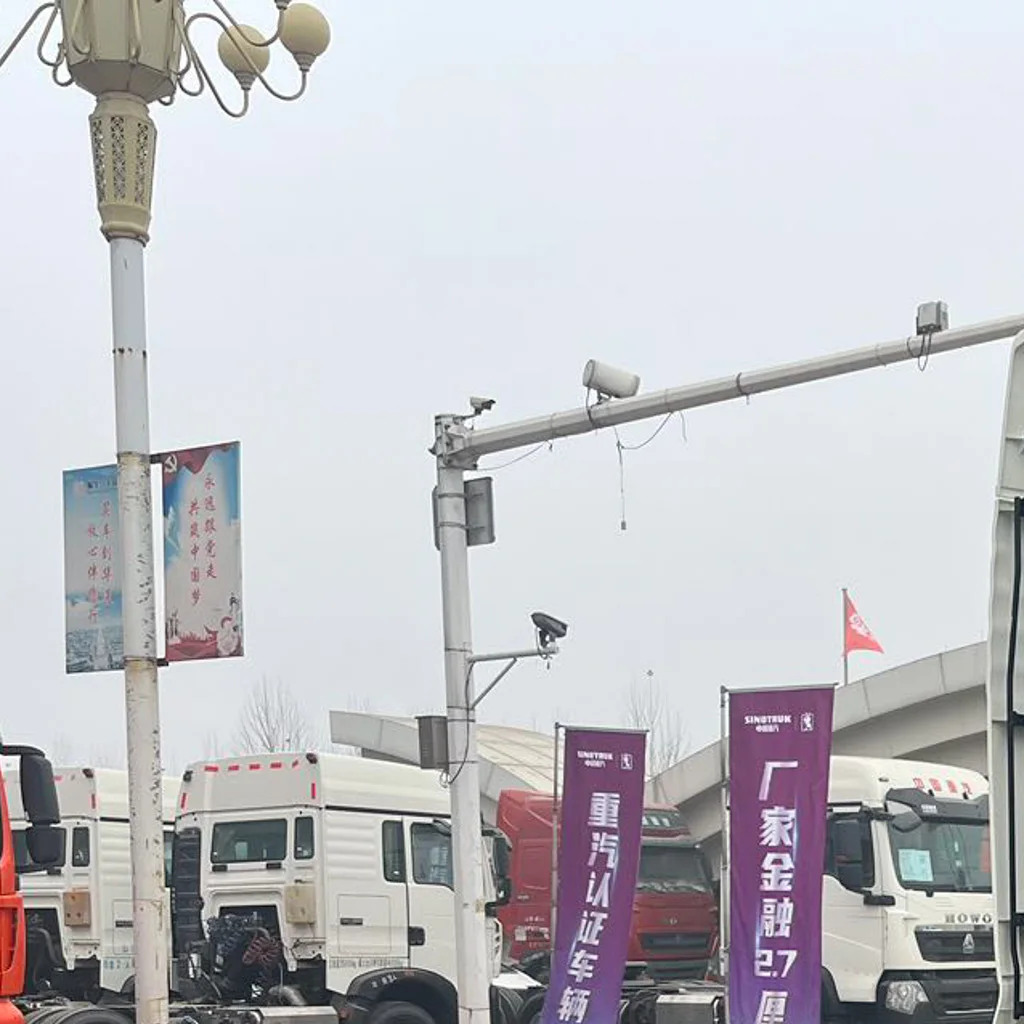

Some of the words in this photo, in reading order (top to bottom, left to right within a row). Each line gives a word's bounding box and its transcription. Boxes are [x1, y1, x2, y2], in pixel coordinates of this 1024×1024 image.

[743, 713, 792, 725] SINOTRUK
[557, 792, 621, 1024] 重汽认证车辆
[945, 912, 992, 924] HOWO
